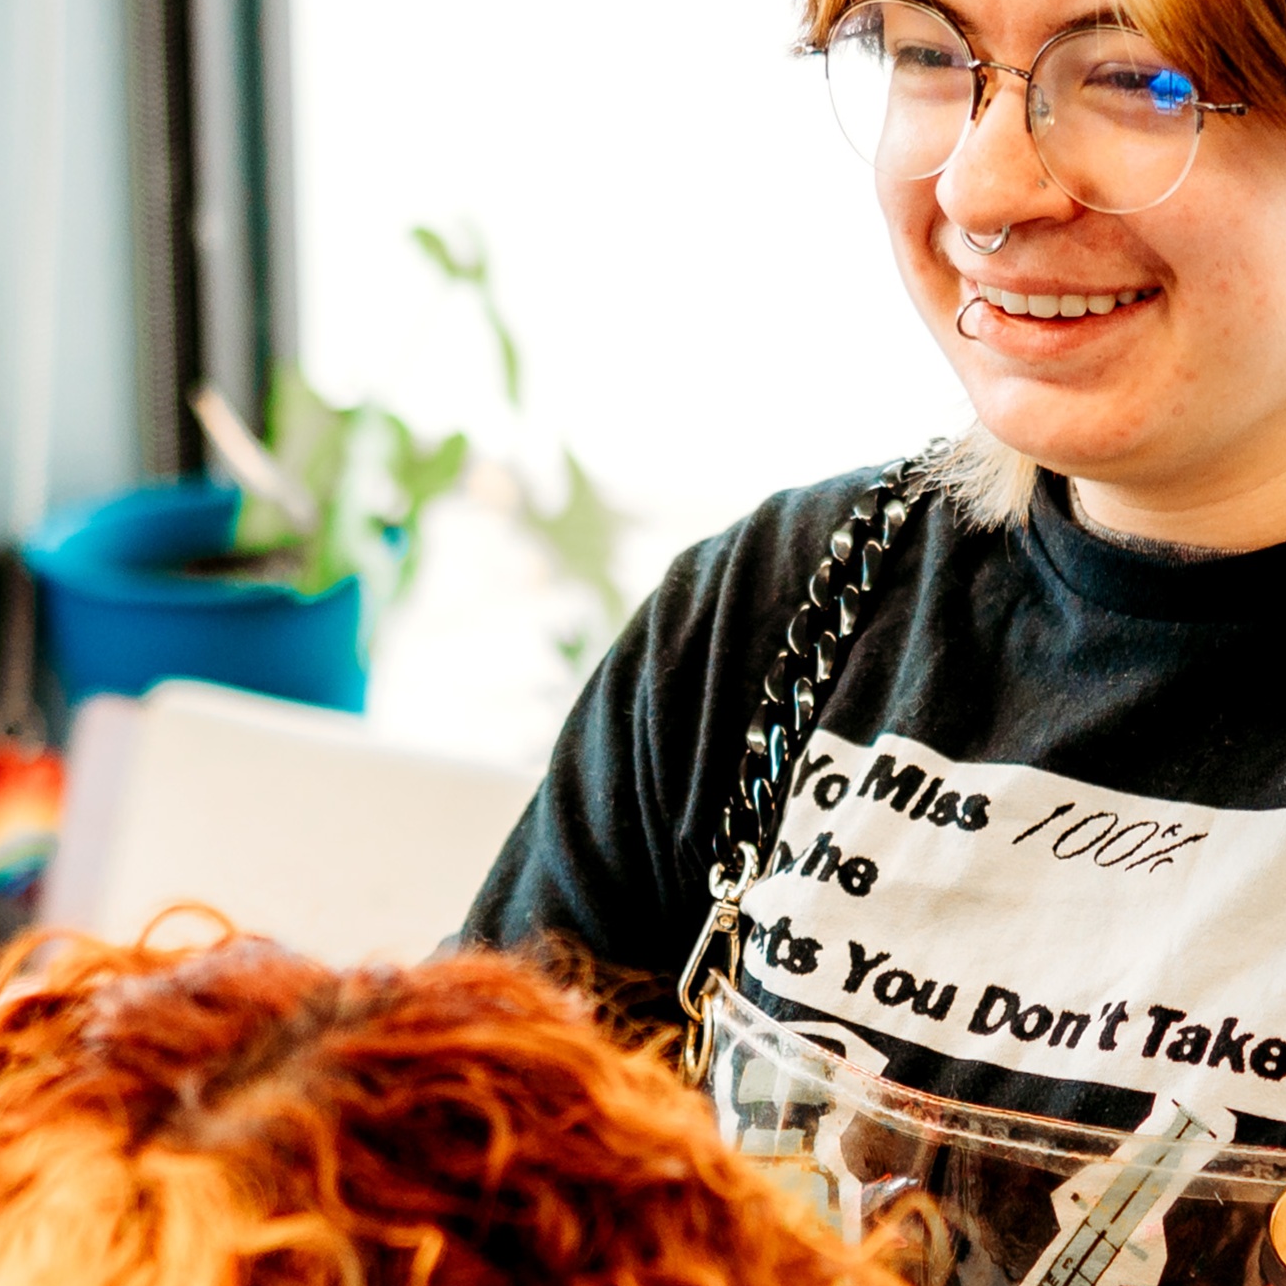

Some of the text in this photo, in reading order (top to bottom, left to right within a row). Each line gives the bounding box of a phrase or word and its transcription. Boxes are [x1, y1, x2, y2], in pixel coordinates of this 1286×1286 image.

[792, 749, 1209, 873] Yo Miss 100%
[843, 940, 959, 1020] You
[967, 984, 1129, 1051] Don't
